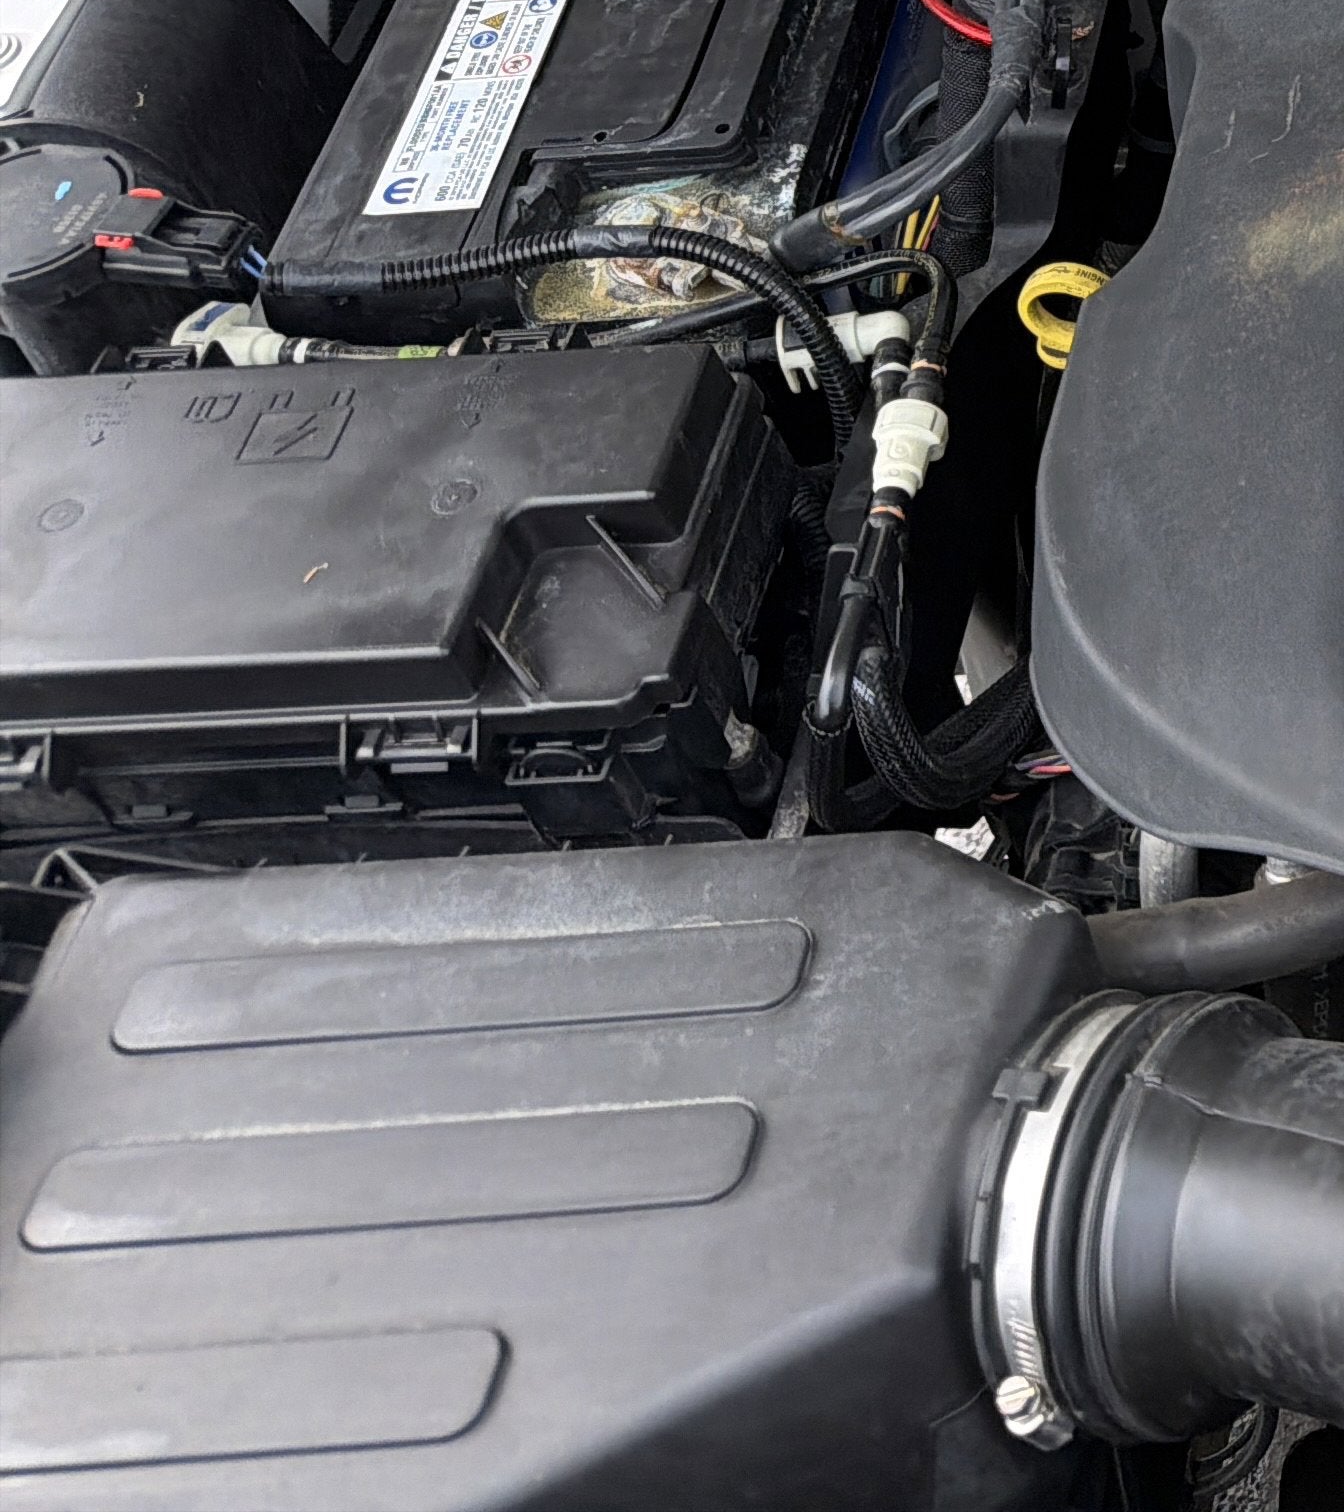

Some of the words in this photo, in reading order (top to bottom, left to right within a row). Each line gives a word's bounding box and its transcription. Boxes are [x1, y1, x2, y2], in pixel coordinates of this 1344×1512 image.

[452, 14, 479, 59] DANGER
[441, 99, 470, 151] REPLACEMENT
[446, 101, 459, 116] FREE
[435, 185, 451, 201] 600
[446, 171, 457, 183] CCA
[457, 137, 471, 148] 70
[473, 97, 489, 112] 120
[1074, 269, 1105, 286] NGINE
